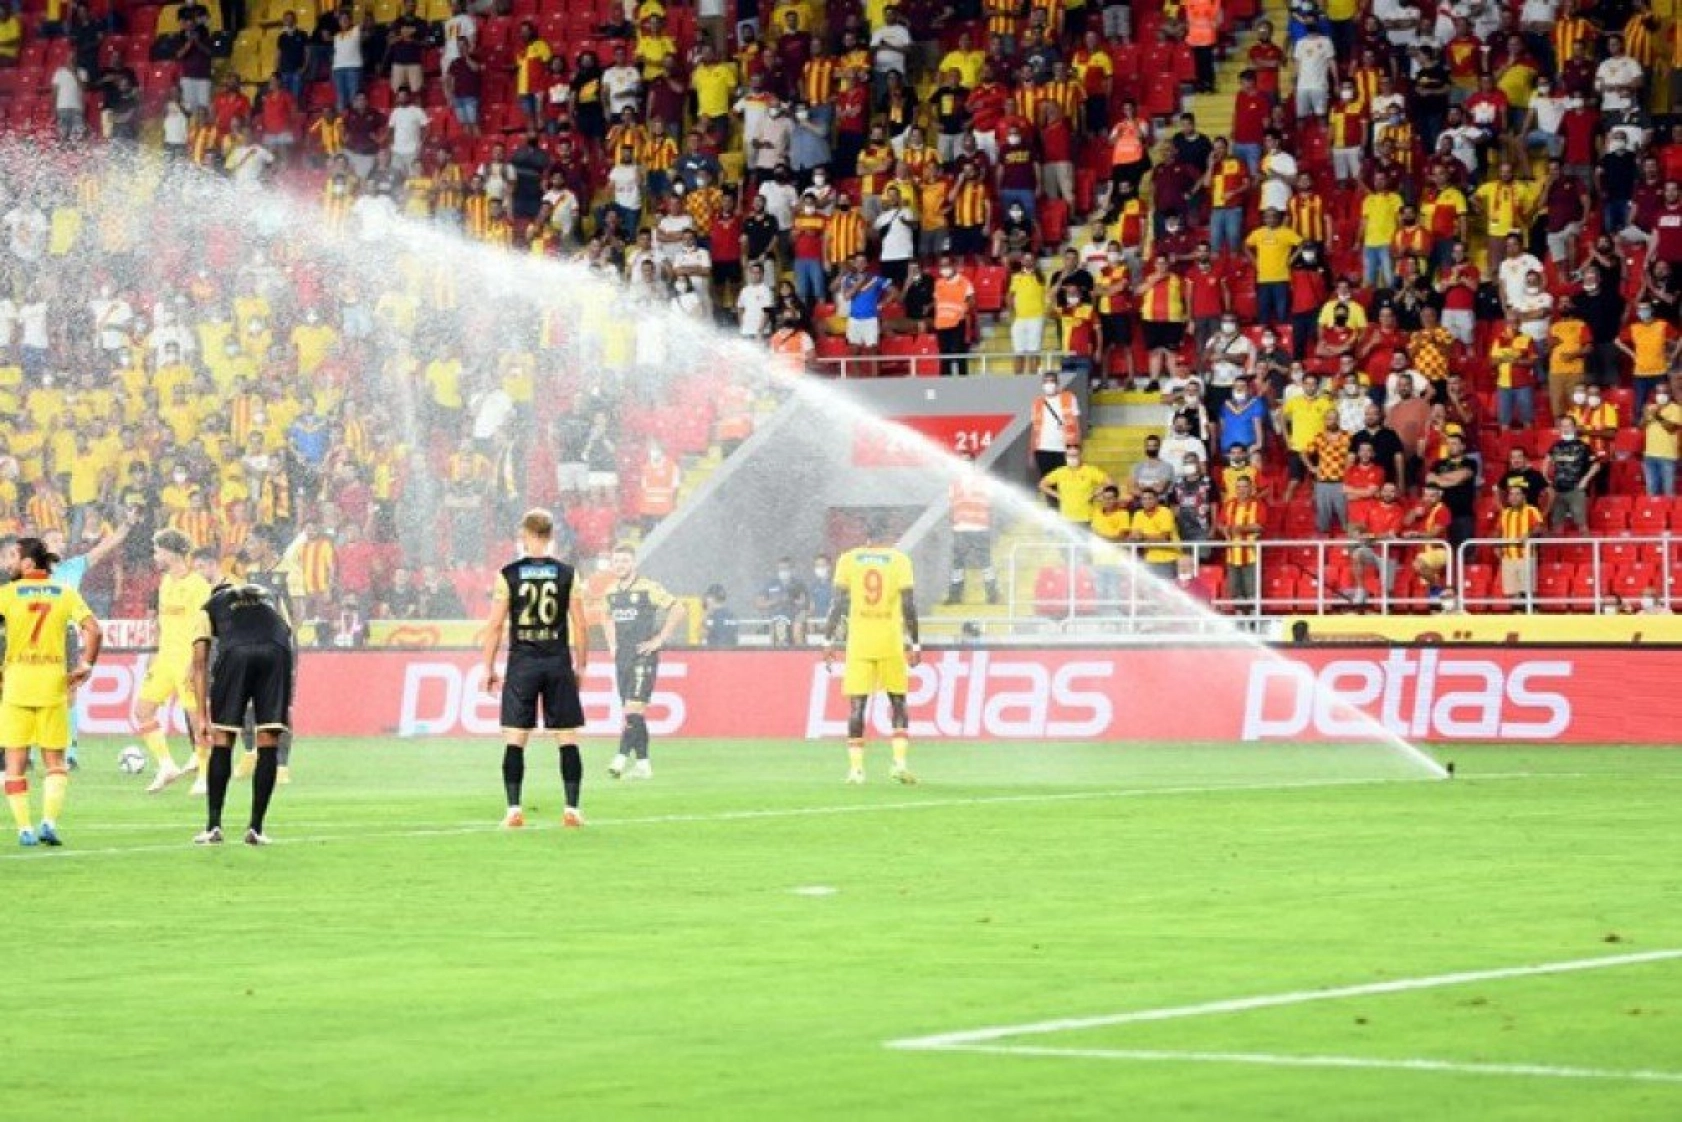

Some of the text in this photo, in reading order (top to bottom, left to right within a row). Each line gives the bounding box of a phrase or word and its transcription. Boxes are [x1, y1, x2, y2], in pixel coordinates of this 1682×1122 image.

[954, 430, 991, 451] 214
[518, 581, 559, 627] 26
[864, 569, 883, 606] 9
[28, 601, 52, 647] 7
[1242, 648, 1572, 741] petlas
